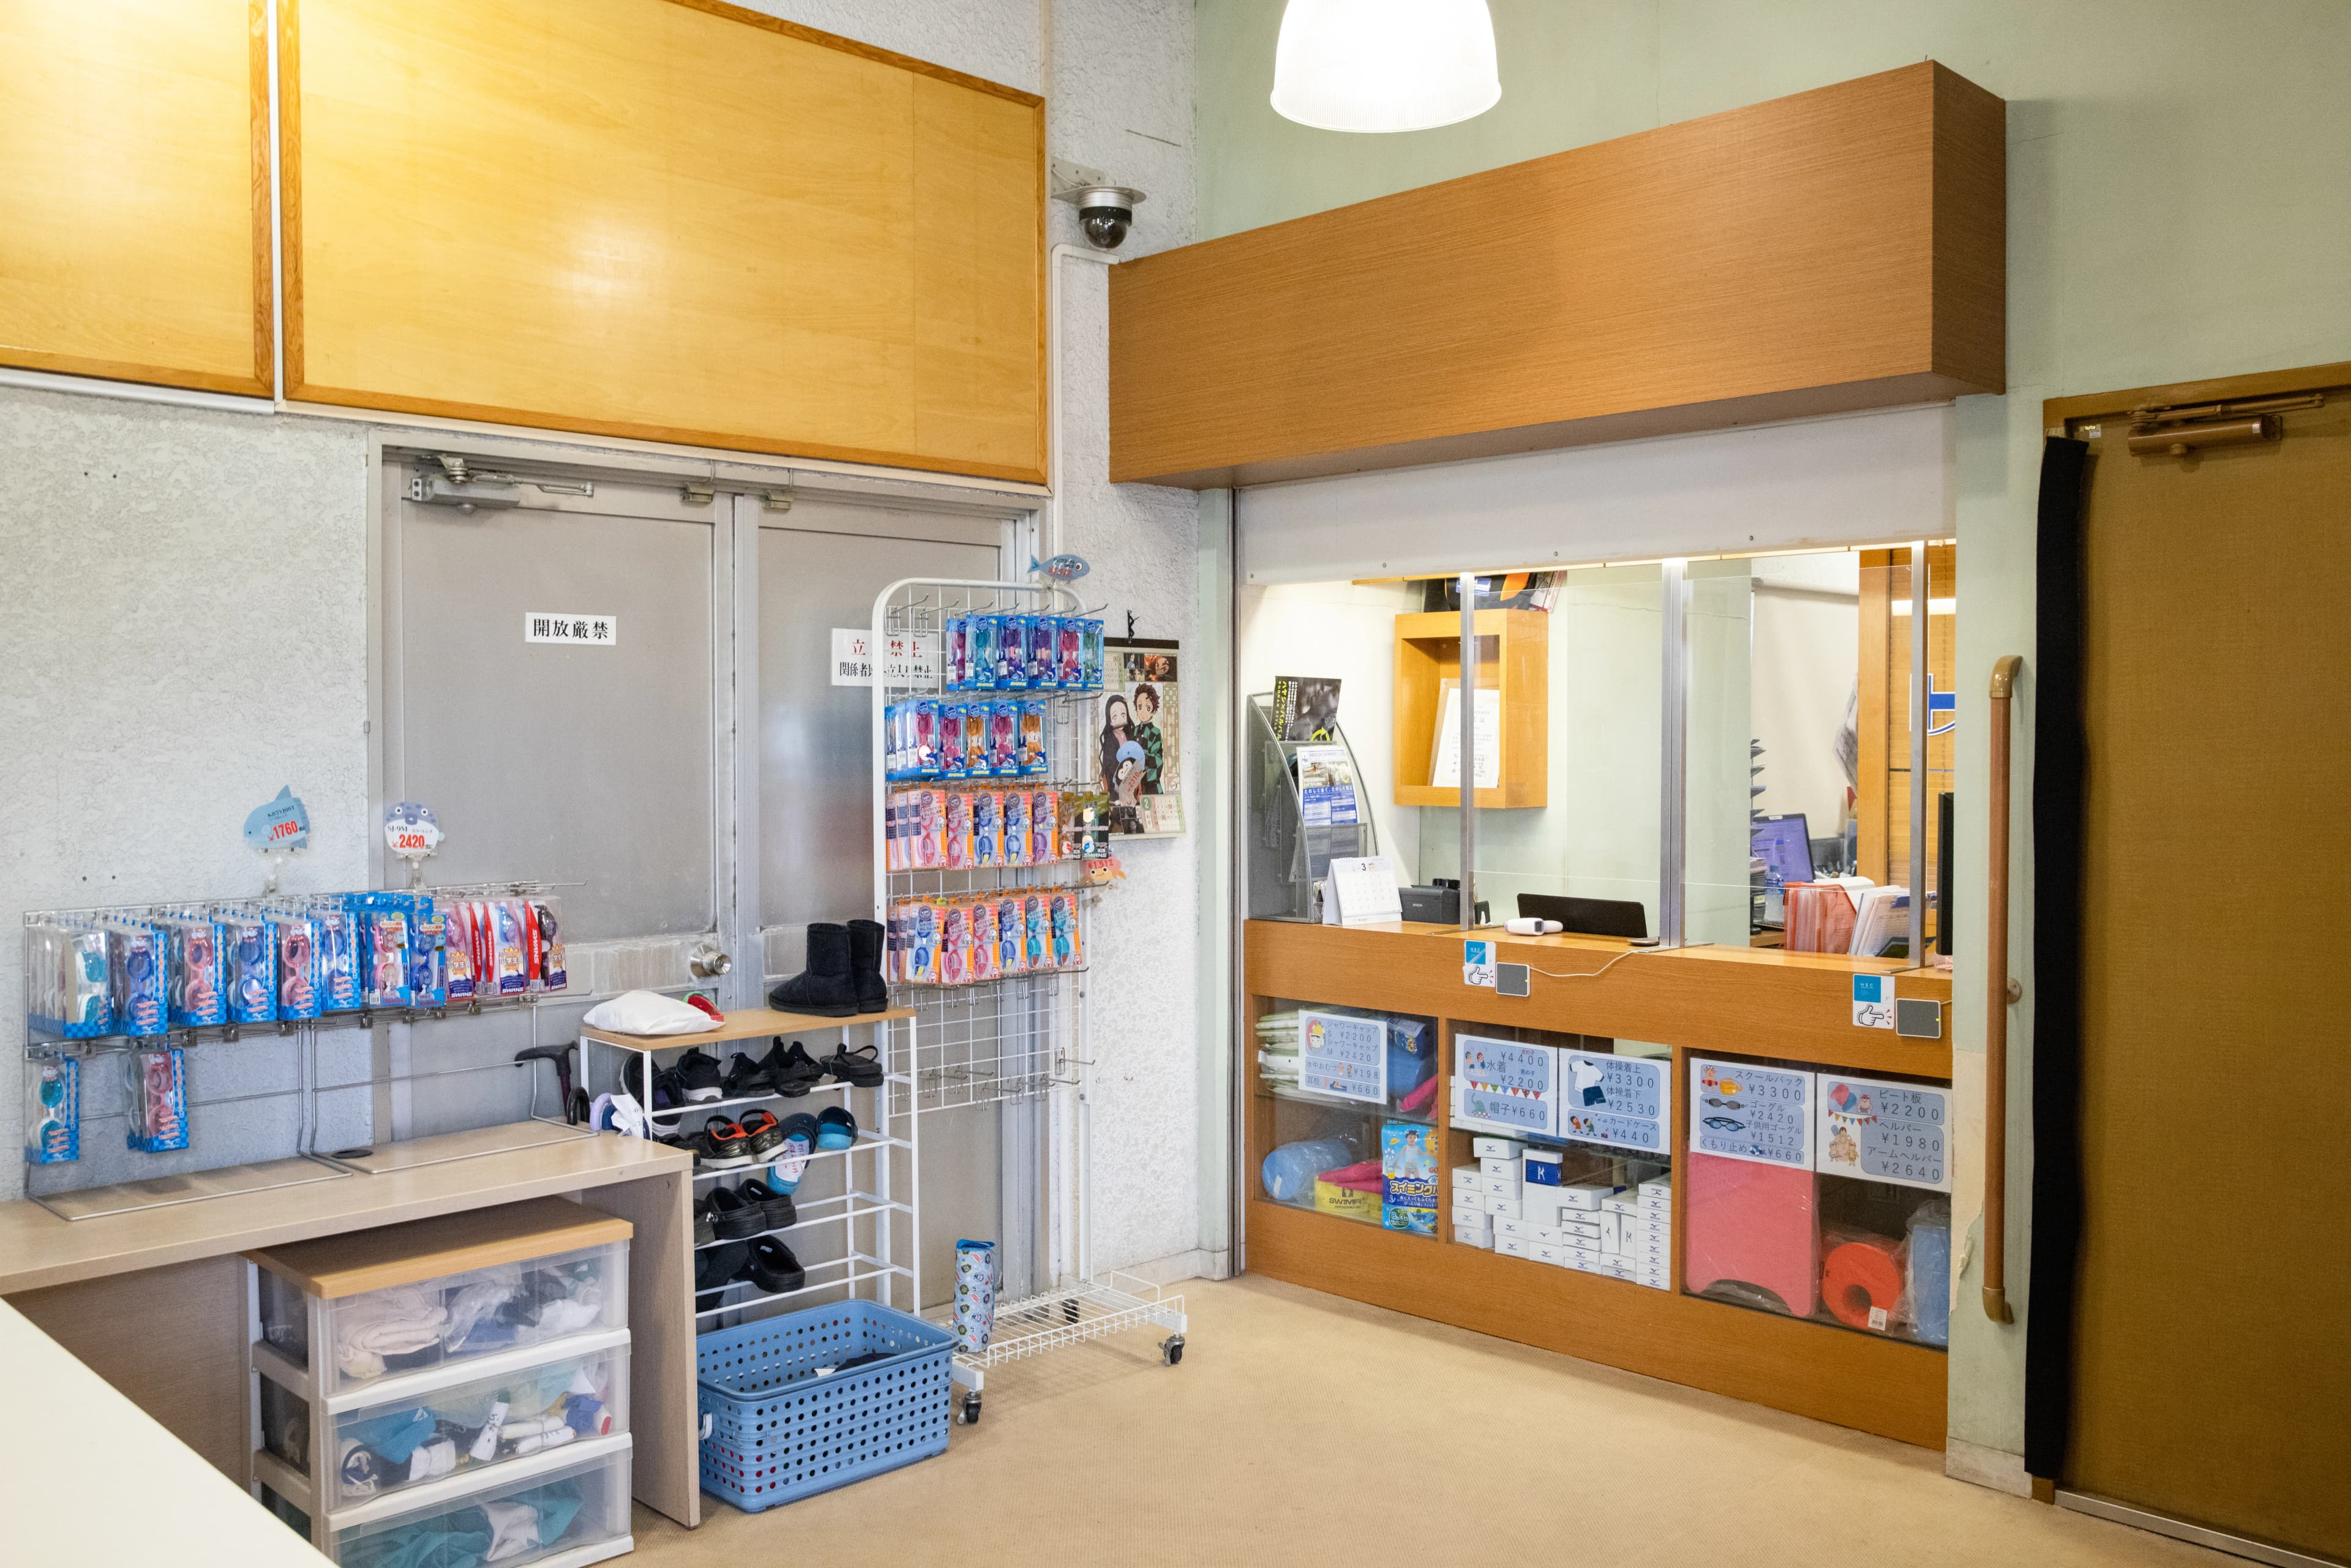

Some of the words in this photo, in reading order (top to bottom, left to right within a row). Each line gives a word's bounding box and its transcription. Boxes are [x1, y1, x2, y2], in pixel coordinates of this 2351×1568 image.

[533, 618, 609, 640] 開放厳禁
[851, 639, 922, 658] 立禁止
[1144, 798, 1149, 809] 2
[268, 820, 298, 841] ¥1760
[392, 833, 425, 849] ¥2420
[1361, 863, 1367, 871] 3
[1327, 1021, 1377, 1033] シャワーキャップ
[1340, 1031, 1371, 1043] ¥2200
[1327, 1040, 1377, 1052] シャワーキャップ
[1340, 1051, 1371, 1062] ¥2420
[1501, 1051, 1543, 1067] ¥4400
[1307, 1060, 1337, 1071] 水中おむつ
[1354, 1067, 1378, 1079] ¥198
[1487, 1059, 1507, 1073] 水着
[1520, 1068, 1535, 1077] 男の子
[1606, 1060, 1641, 1074] 体操着上
[1307, 1076, 1321, 1086] 耳栓
[1352, 1084, 1378, 1095] ¥660
[1501, 1074, 1543, 1090] ¥2200
[1607, 1072, 1654, 1089] ¥3300
[1606, 1086, 1641, 1100] 体操着下
[1749, 1083, 1801, 1101] ¥3300
[1879, 1089, 1921, 1104] ビート板
[1490, 1101, 1510, 1115] 帽子
[1512, 1105, 1545, 1121] ¥660
[1608, 1099, 1655, 1116] ¥2530
[1750, 1101, 1785, 1112] ゴーグル
[1881, 1102, 1939, 1120] ¥2200
[1610, 1117, 1657, 1131] カードケース
[1750, 1109, 1793, 1124] ¥2420
[1745, 1120, 1802, 1135] 子供用ゴーグル
[1879, 1122, 1922, 1132] ヘルパー
[1613, 1128, 1649, 1144] ¥440
[1751, 1131, 1794, 1146] ¥1512
[1881, 1132, 1940, 1151] ¥1980
[1701, 1138, 1747, 1152] くもり止め
[1768, 1148, 1801, 1161] ¥660
[1867, 1146, 1942, 1163] アームヘルパー
[1881, 1160, 1940, 1180] ¥2640
